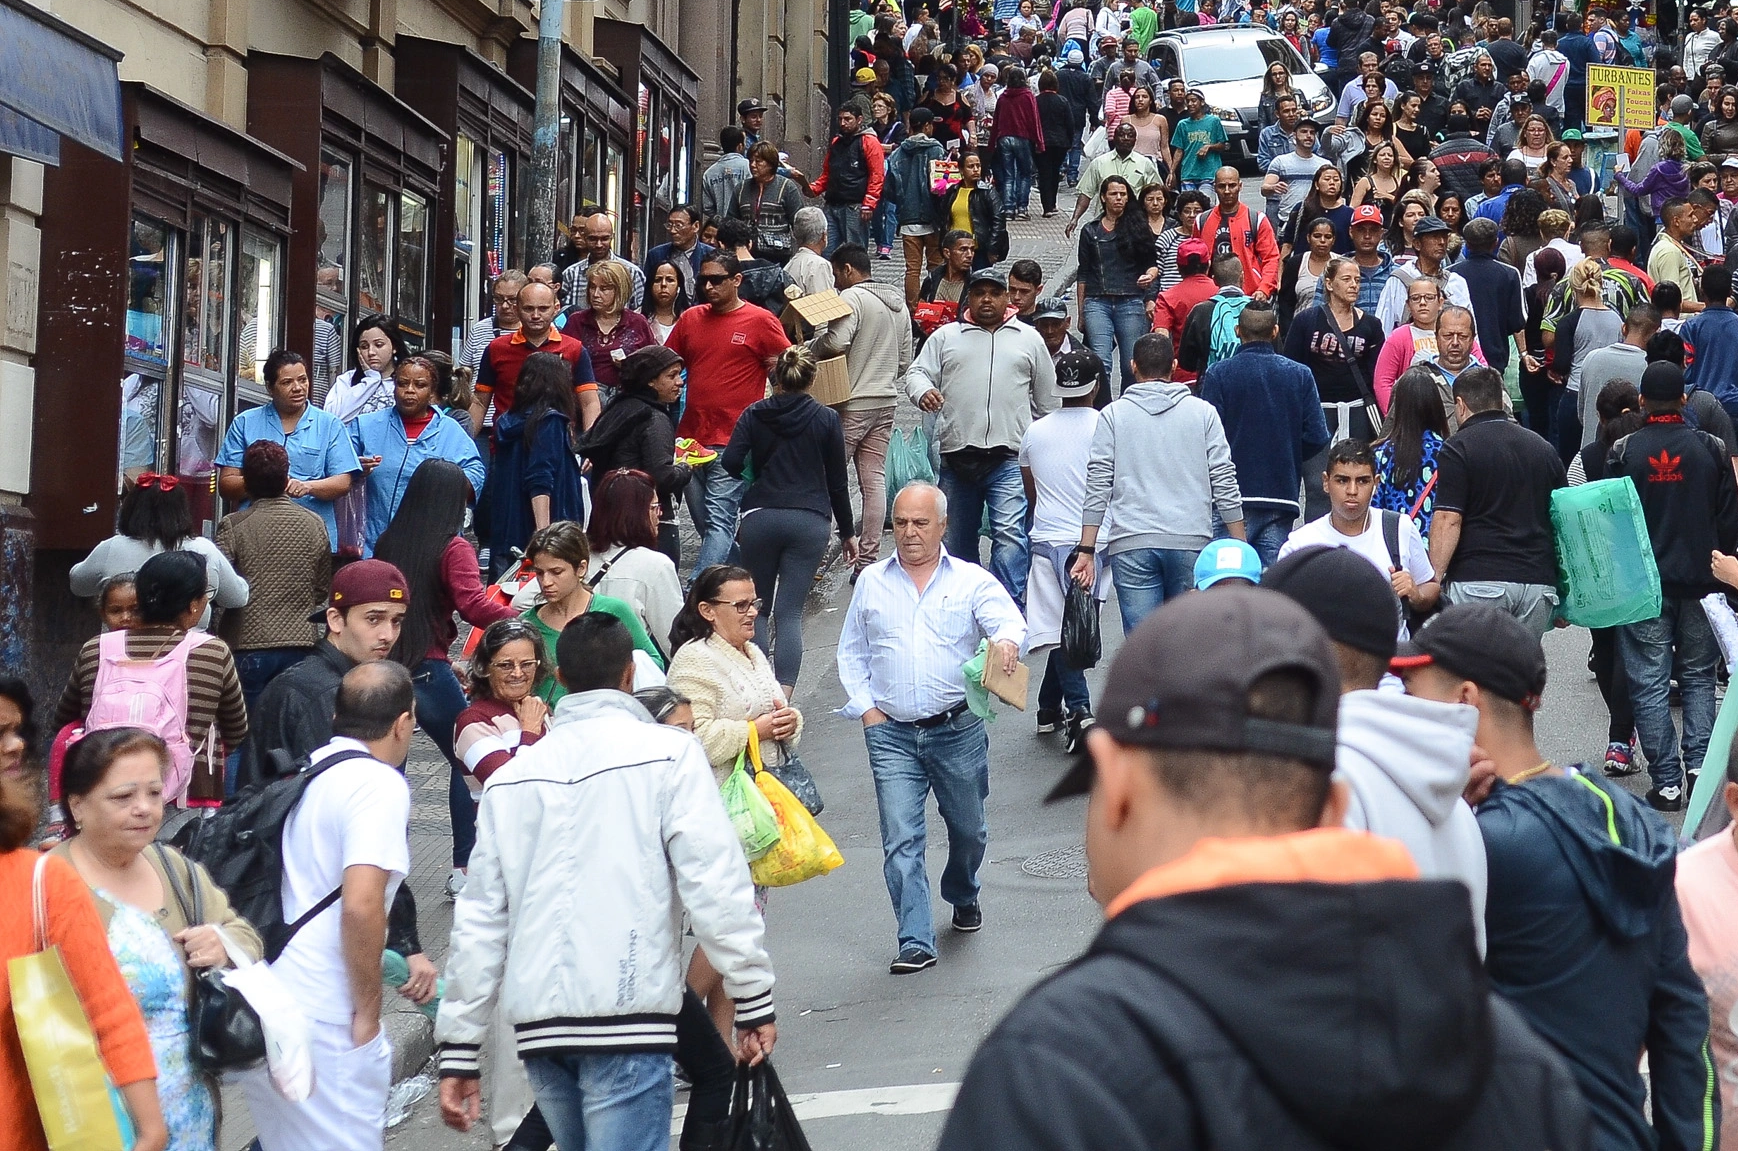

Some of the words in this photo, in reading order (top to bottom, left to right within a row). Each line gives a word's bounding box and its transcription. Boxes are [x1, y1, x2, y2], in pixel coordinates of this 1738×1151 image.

[1591, 68, 1651, 86] TURBANTES
[1627, 88, 1651, 97] Faixas
[1626, 98, 1652, 107] Toucas
[1625, 107, 1652, 116] Coroas
[1633, 118, 1652, 126] Flores
[1647, 470, 1684, 483] adidas
